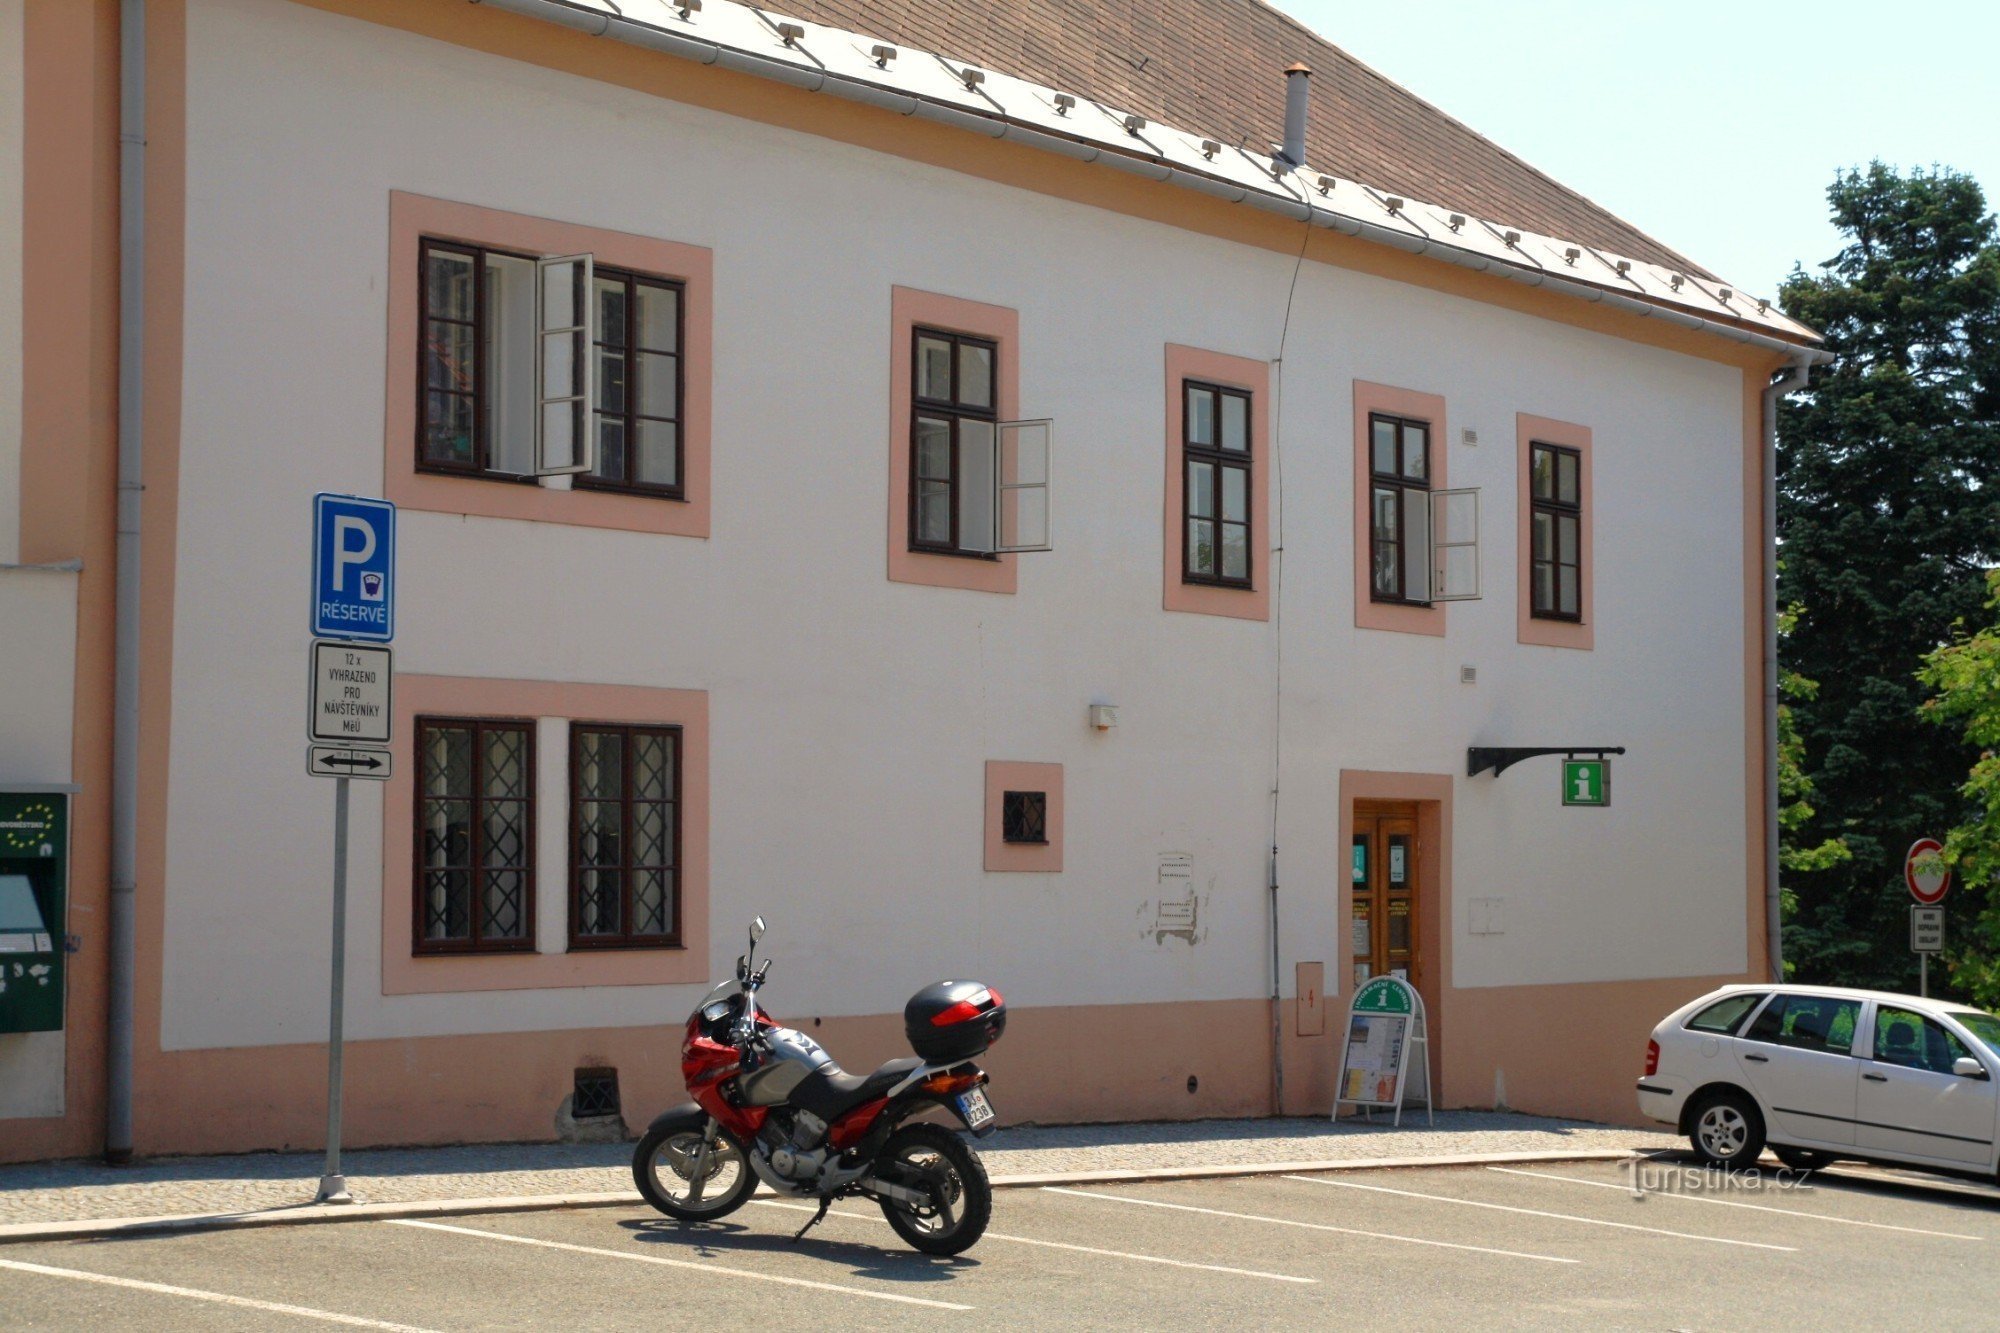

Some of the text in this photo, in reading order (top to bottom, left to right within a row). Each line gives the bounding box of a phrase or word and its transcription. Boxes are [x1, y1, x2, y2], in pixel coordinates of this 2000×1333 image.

[332, 514, 377, 592] P
[321, 599, 386, 624] RÉSERVÉ
[345, 653, 354, 665] 12
[329, 668, 376, 683] VYHRAZENO
[344, 686, 360, 699] PRO
[324, 700, 380, 717] NÁVŠTĚVNÍKY
[966, 1105, 989, 1124] 8238
